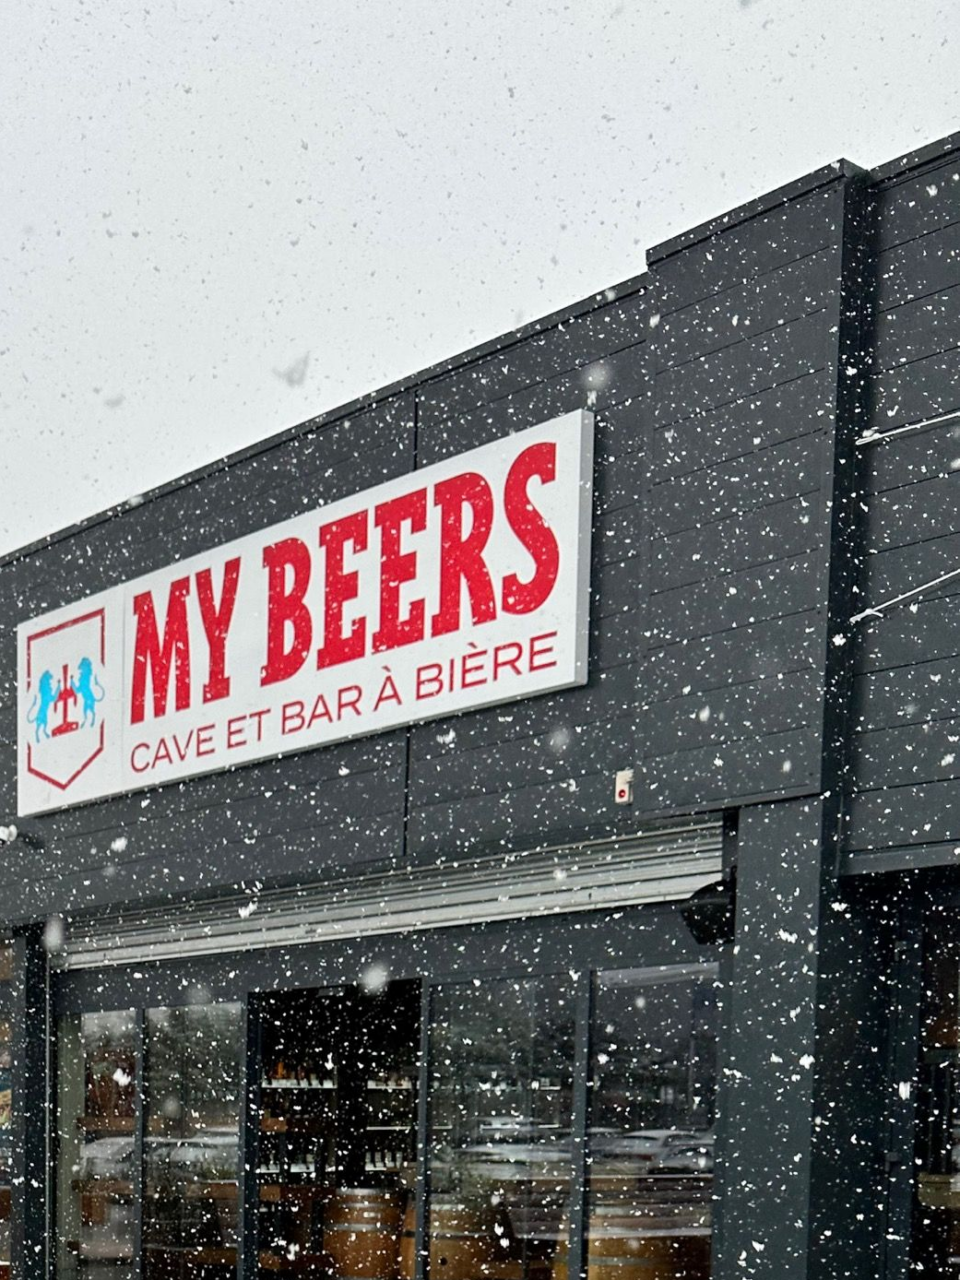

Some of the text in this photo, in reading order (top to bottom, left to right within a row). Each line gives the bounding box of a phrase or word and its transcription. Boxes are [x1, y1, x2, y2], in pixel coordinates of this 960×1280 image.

[130, 441, 560, 725] MY BEERS
[130, 631, 558, 773] CAVE ET BAR À BIÈRE
